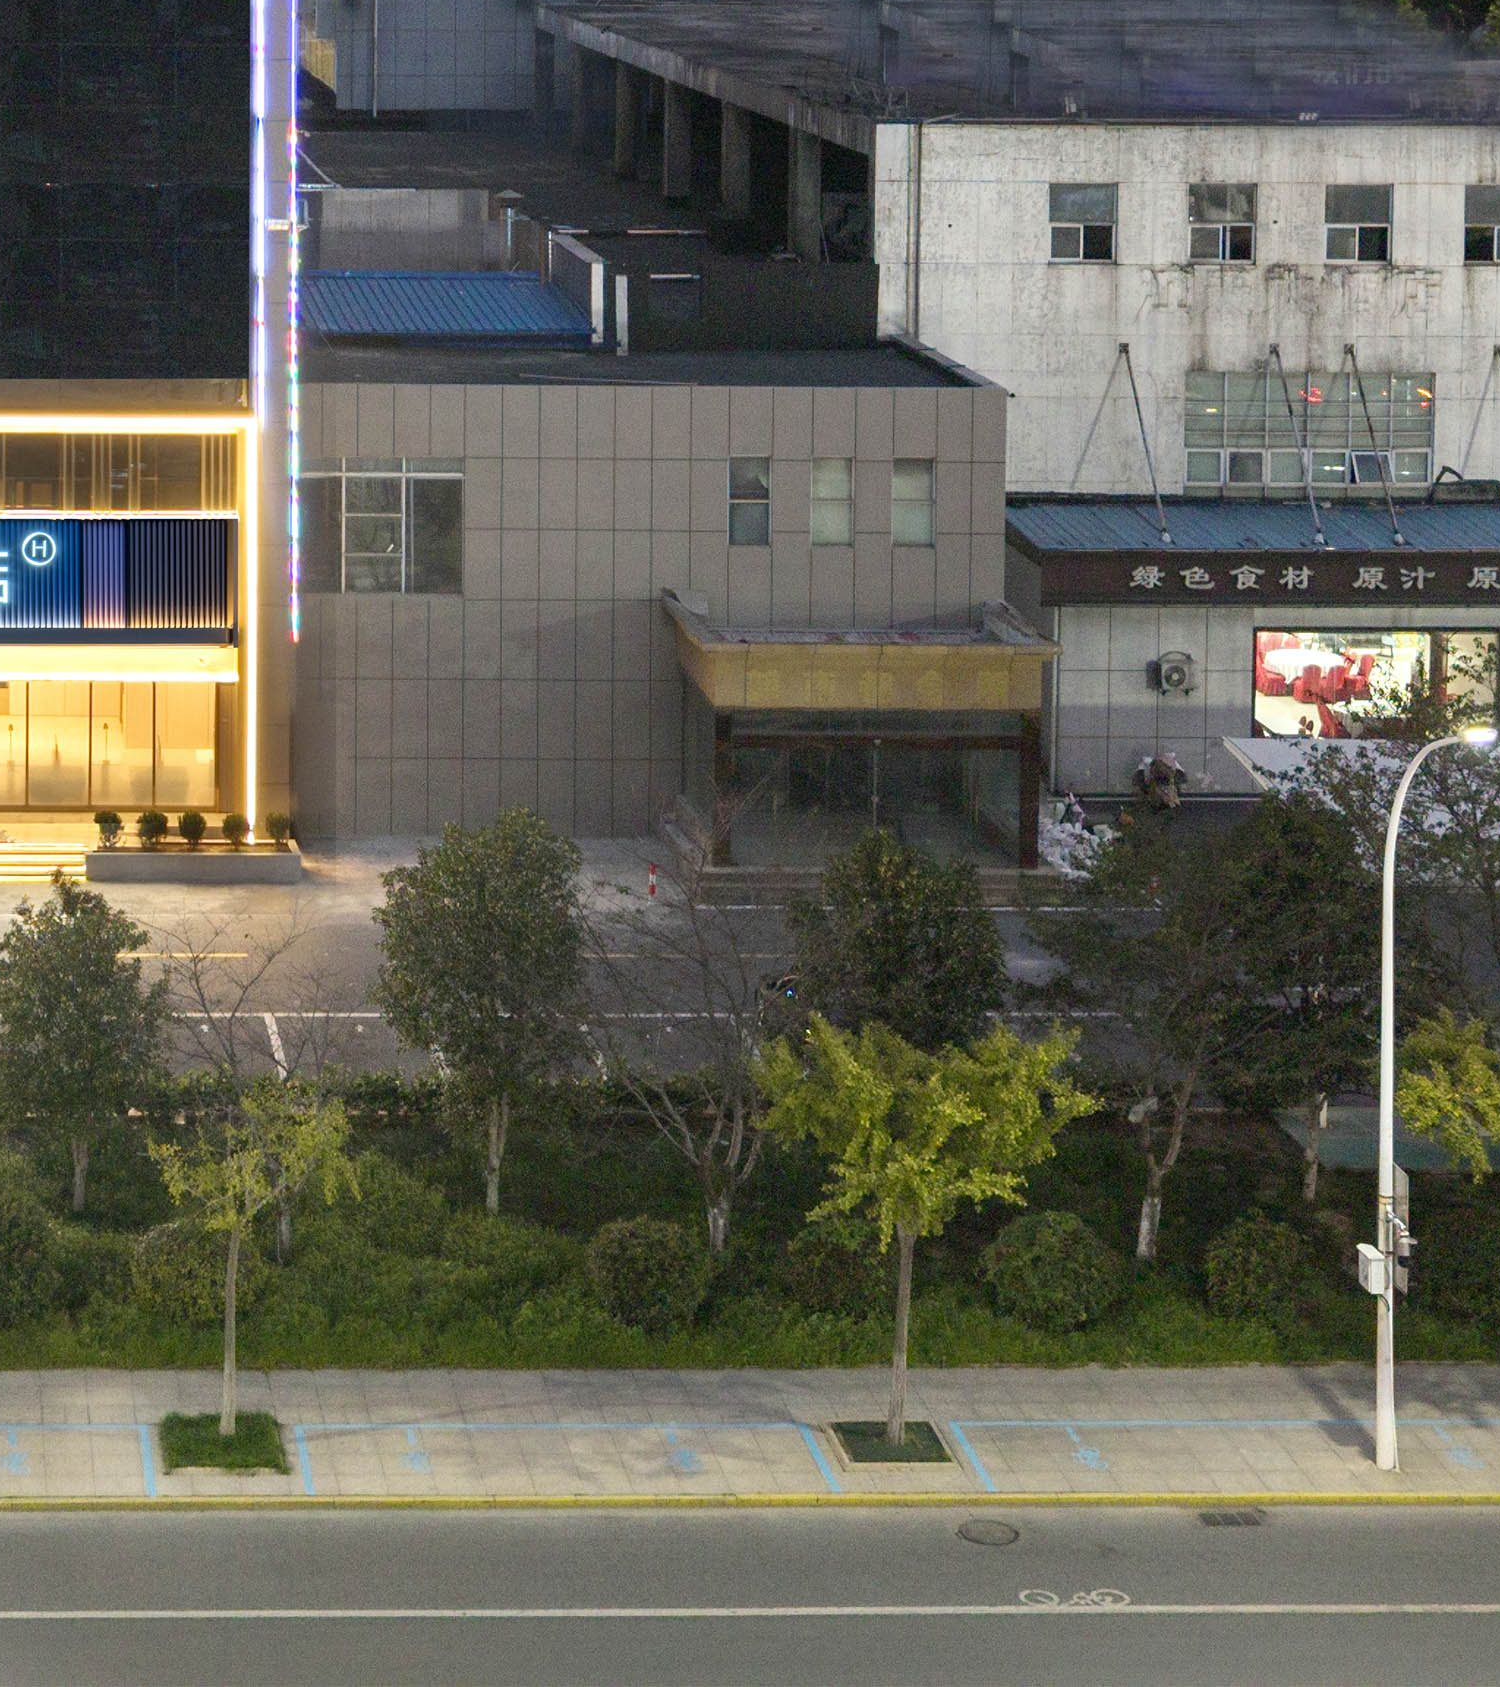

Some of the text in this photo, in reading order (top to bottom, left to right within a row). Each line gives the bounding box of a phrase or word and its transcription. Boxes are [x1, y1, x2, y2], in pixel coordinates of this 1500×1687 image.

[1129, 565, 1315, 590] 绿色食材
[1352, 566, 1435, 590] 原汁
